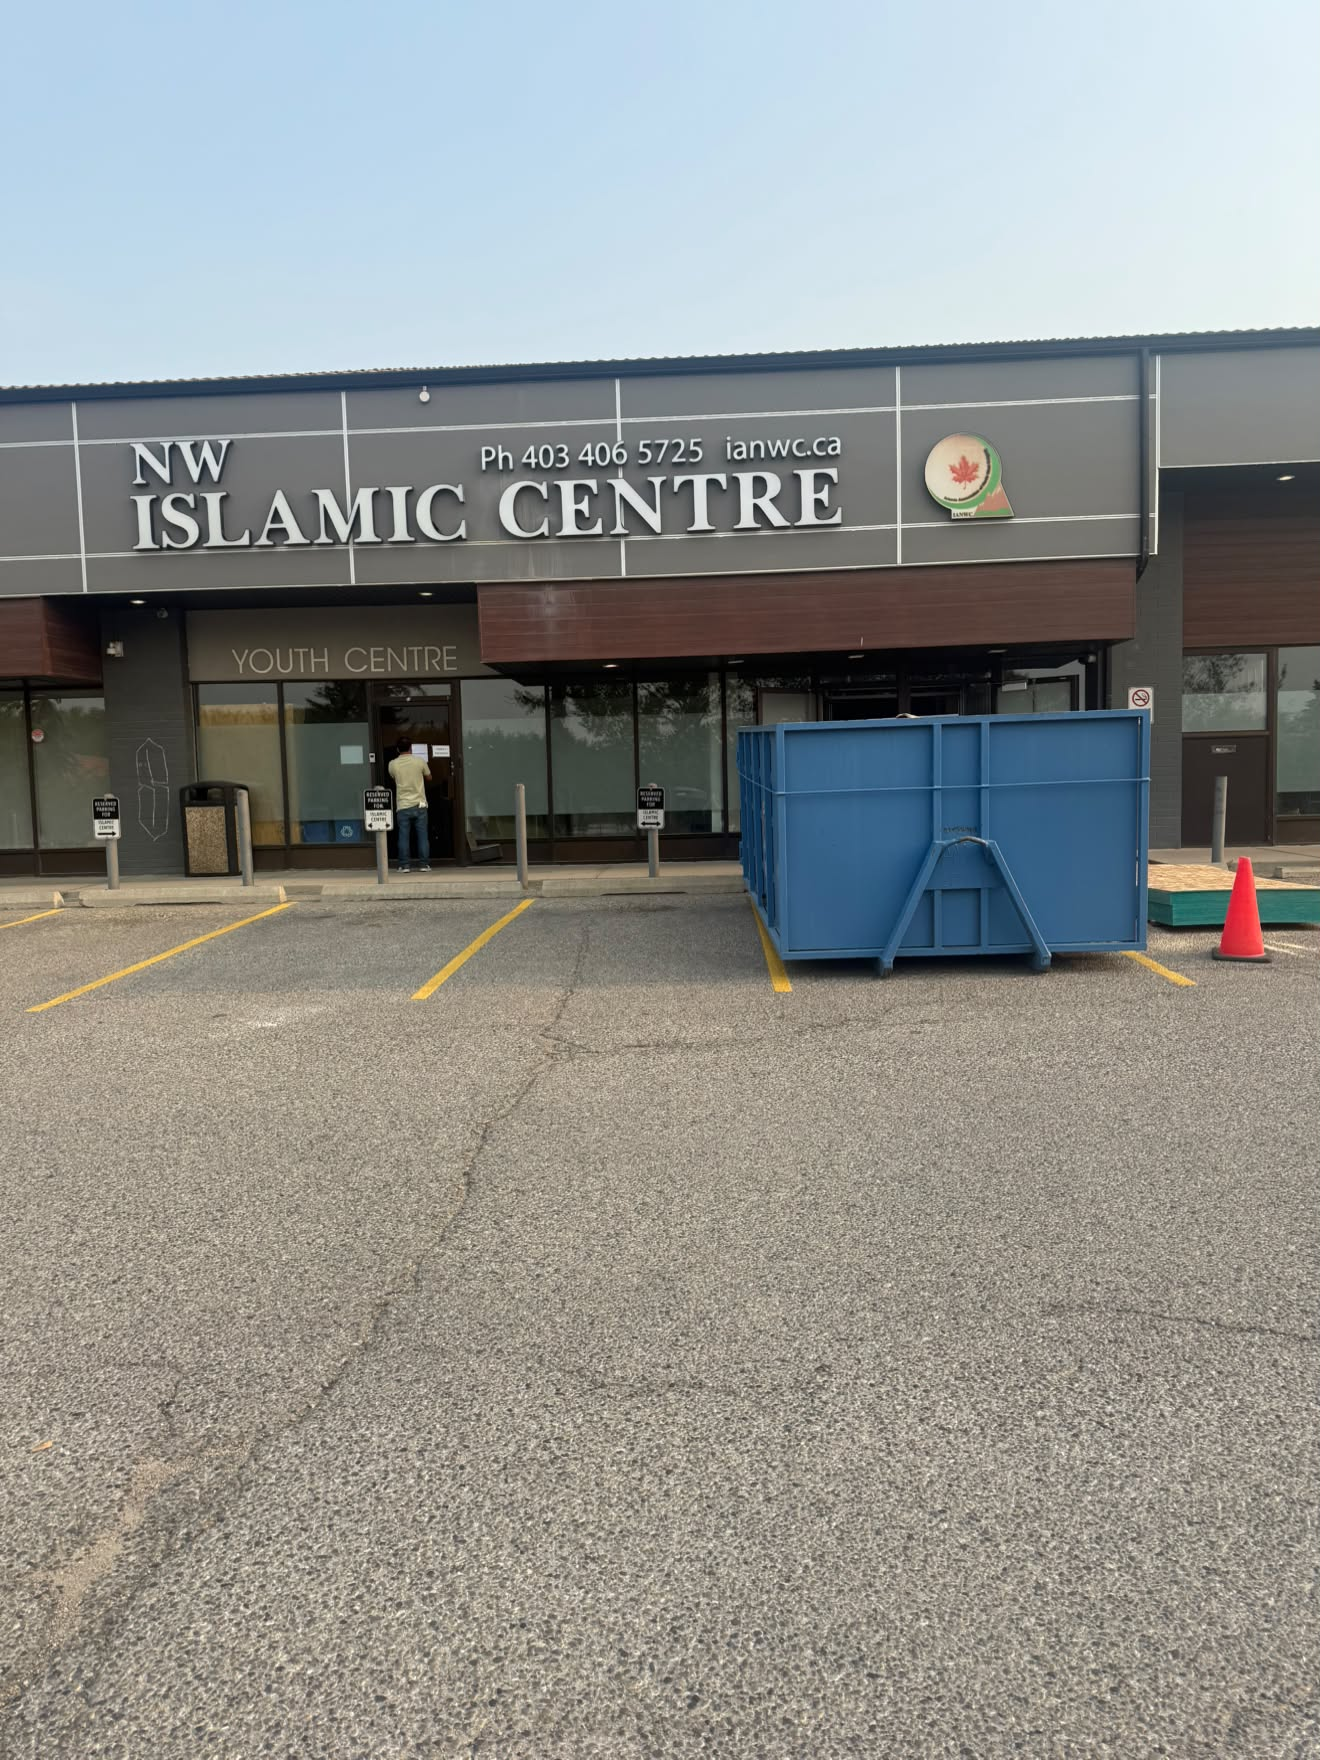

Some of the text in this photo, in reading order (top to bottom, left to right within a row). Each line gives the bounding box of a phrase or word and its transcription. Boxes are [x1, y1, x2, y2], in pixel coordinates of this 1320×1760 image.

[129, 439, 232, 485] NW
[480, 436, 842, 472] Ph 403 406 5725 ianwc.ca
[129, 467, 844, 551] ISLAMIC CENTRE
[231, 645, 458, 674] YOUTH CENTRE
